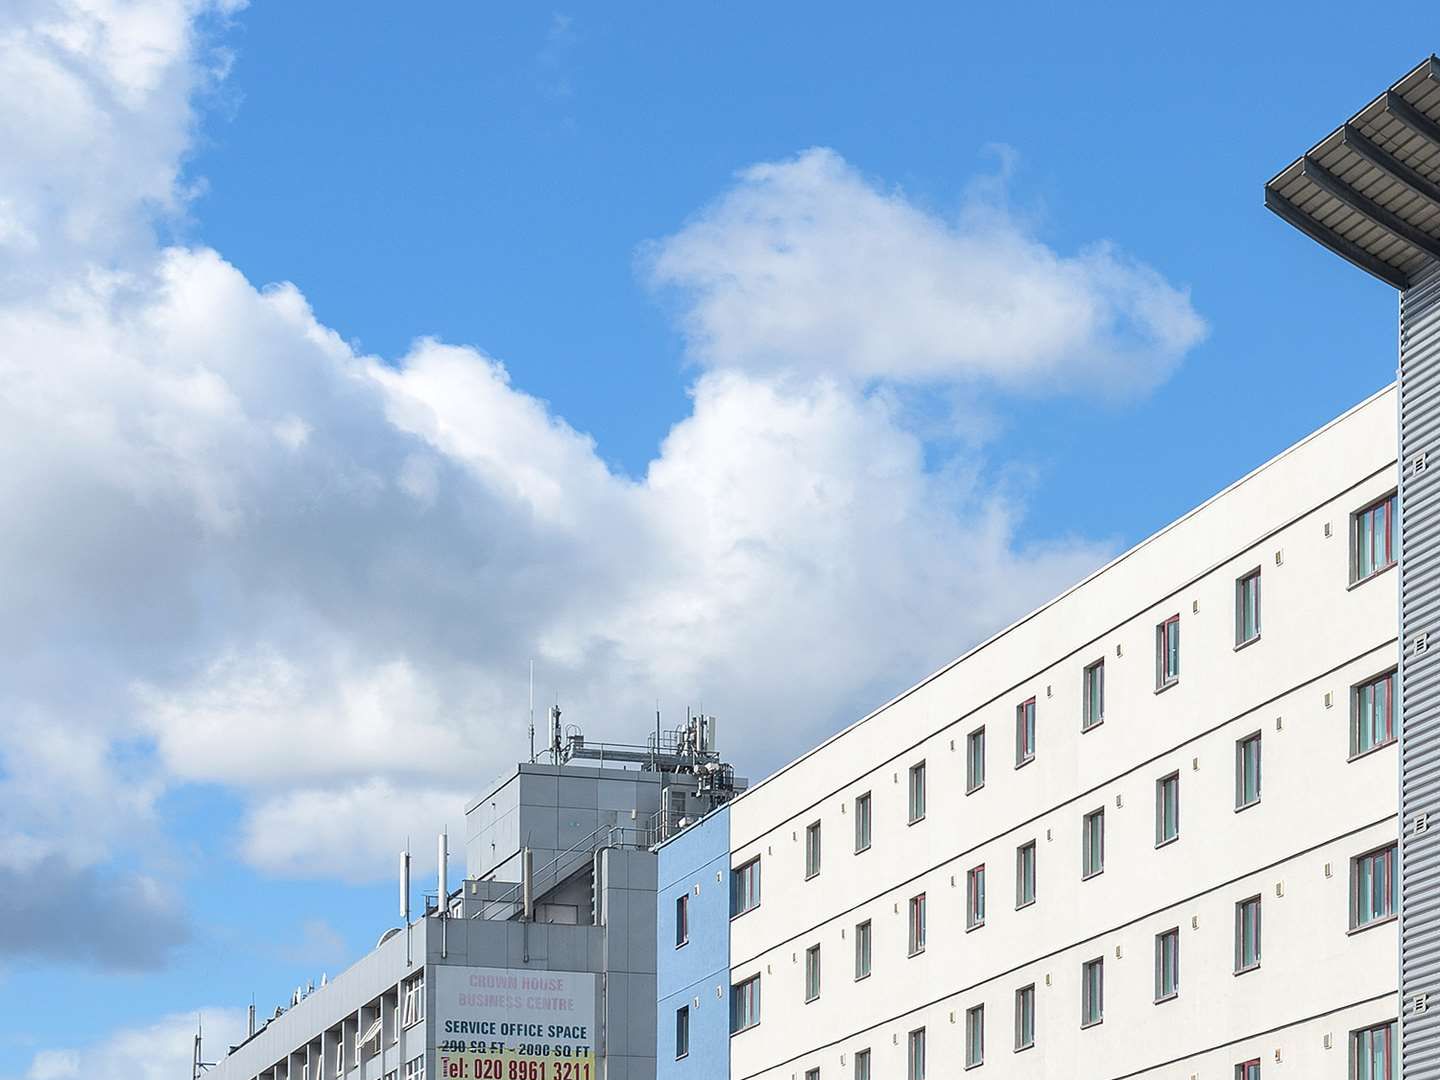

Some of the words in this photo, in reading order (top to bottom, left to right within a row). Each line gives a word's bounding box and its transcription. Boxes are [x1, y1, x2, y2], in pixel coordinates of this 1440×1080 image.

[470, 974, 518, 989] CROWN
[522, 976, 563, 991] HOUSE
[458, 993, 523, 1009] BUSINESS
[526, 995, 575, 1011] CENTRE
[444, 1019, 496, 1035] SERVICE
[500, 1022, 543, 1037] OFFICE
[547, 1024, 587, 1039] SPACE
[554, 1045, 572, 1058] SQ
[575, 1046, 590, 1058] FT
[474, 1058, 503, 1080] 020
[508, 1060, 545, 1080] 8961
